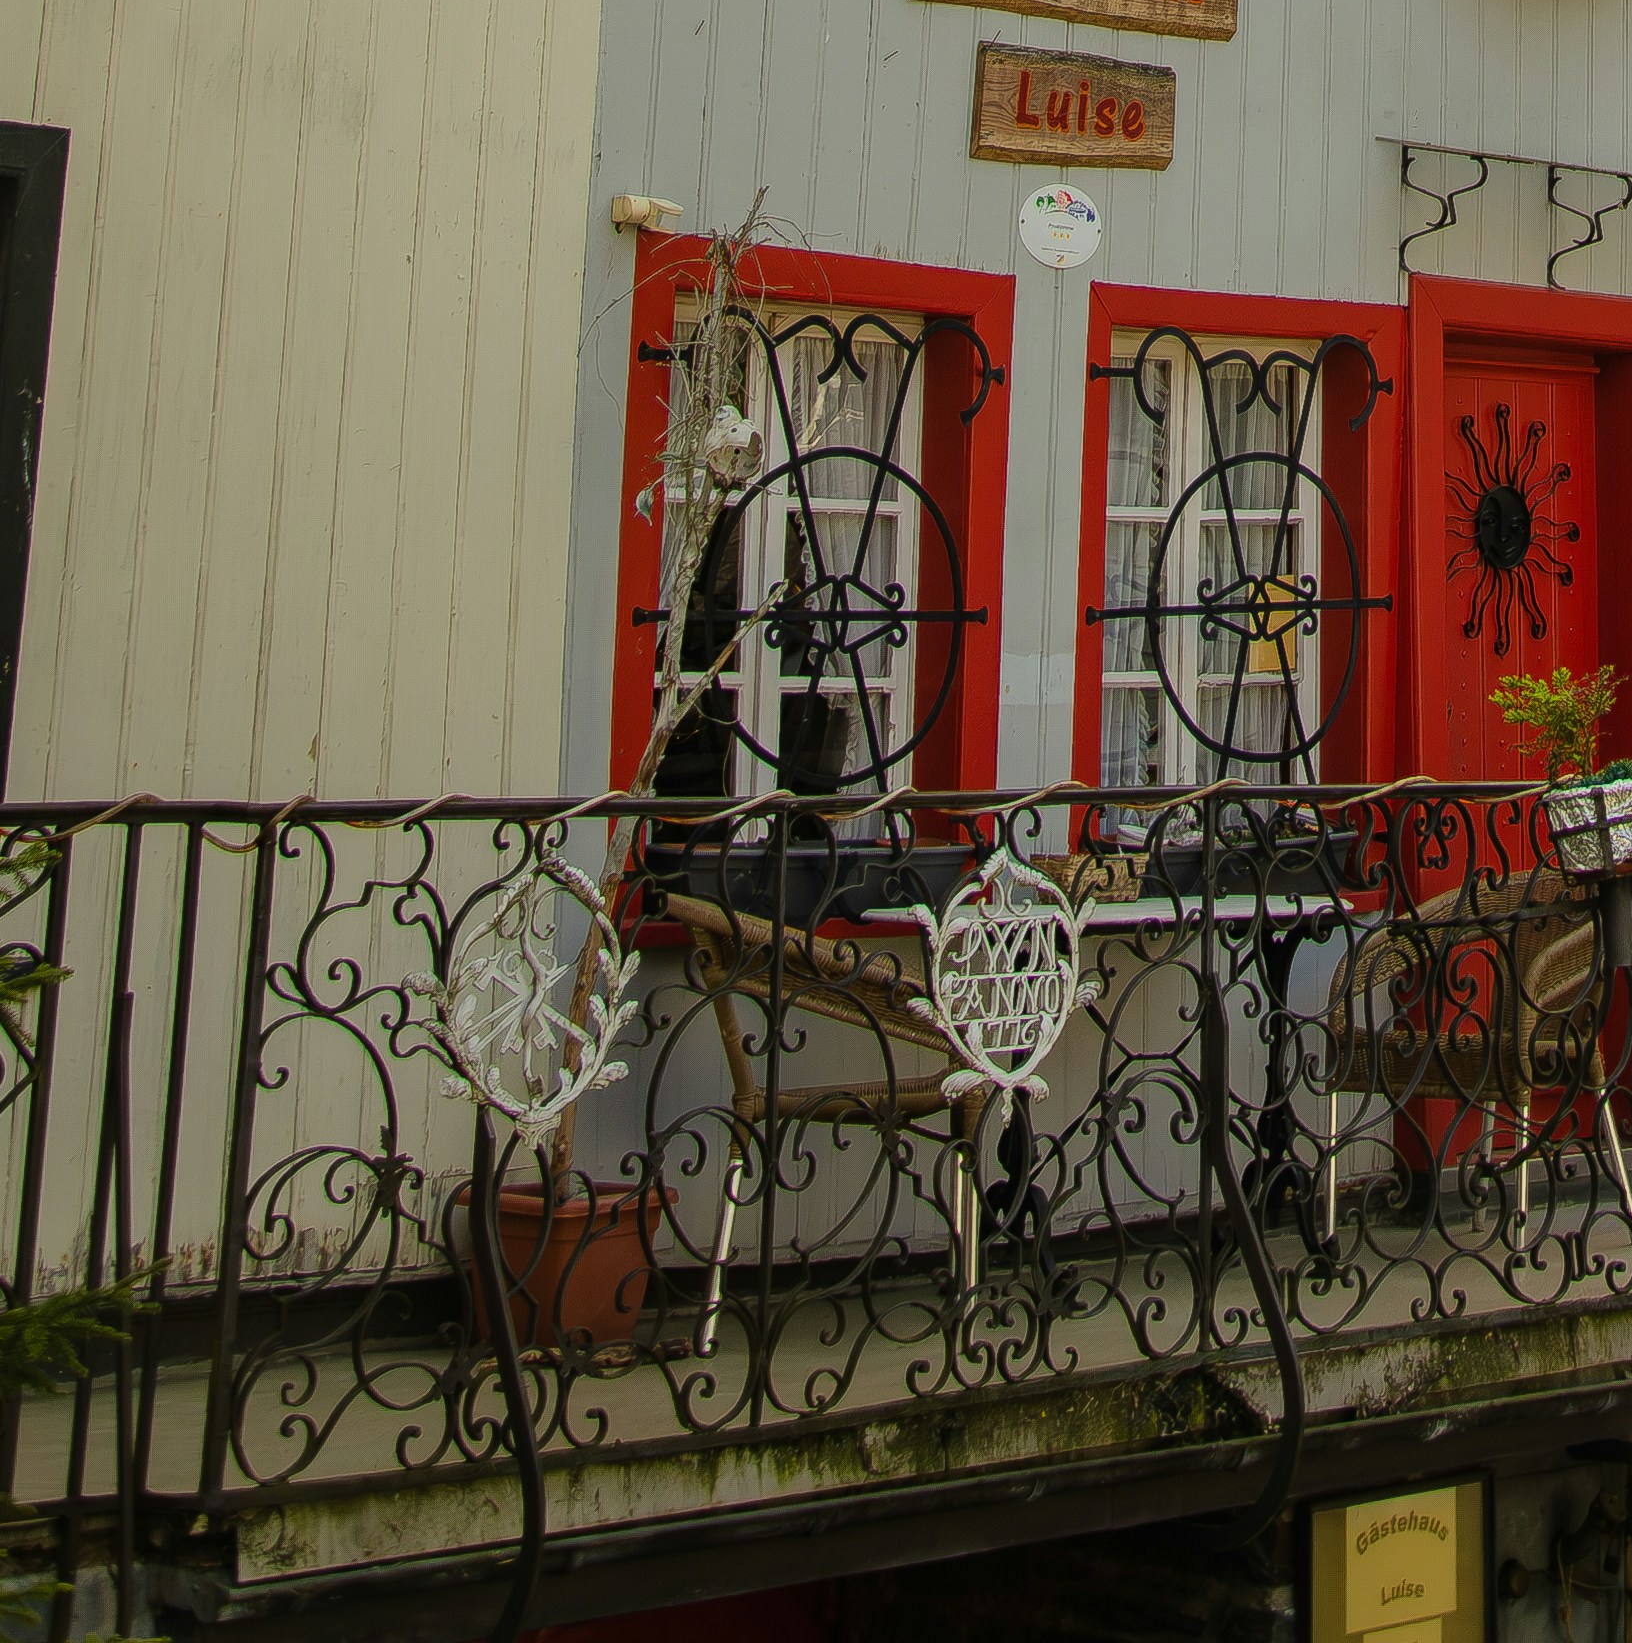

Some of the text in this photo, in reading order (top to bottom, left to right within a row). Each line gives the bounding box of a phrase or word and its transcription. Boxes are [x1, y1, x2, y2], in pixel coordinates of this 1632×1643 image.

[1015, 68, 1147, 142] Luise
[1356, 1509, 1450, 1556] Gästehaus
[1381, 1578, 1425, 1606] Luise
